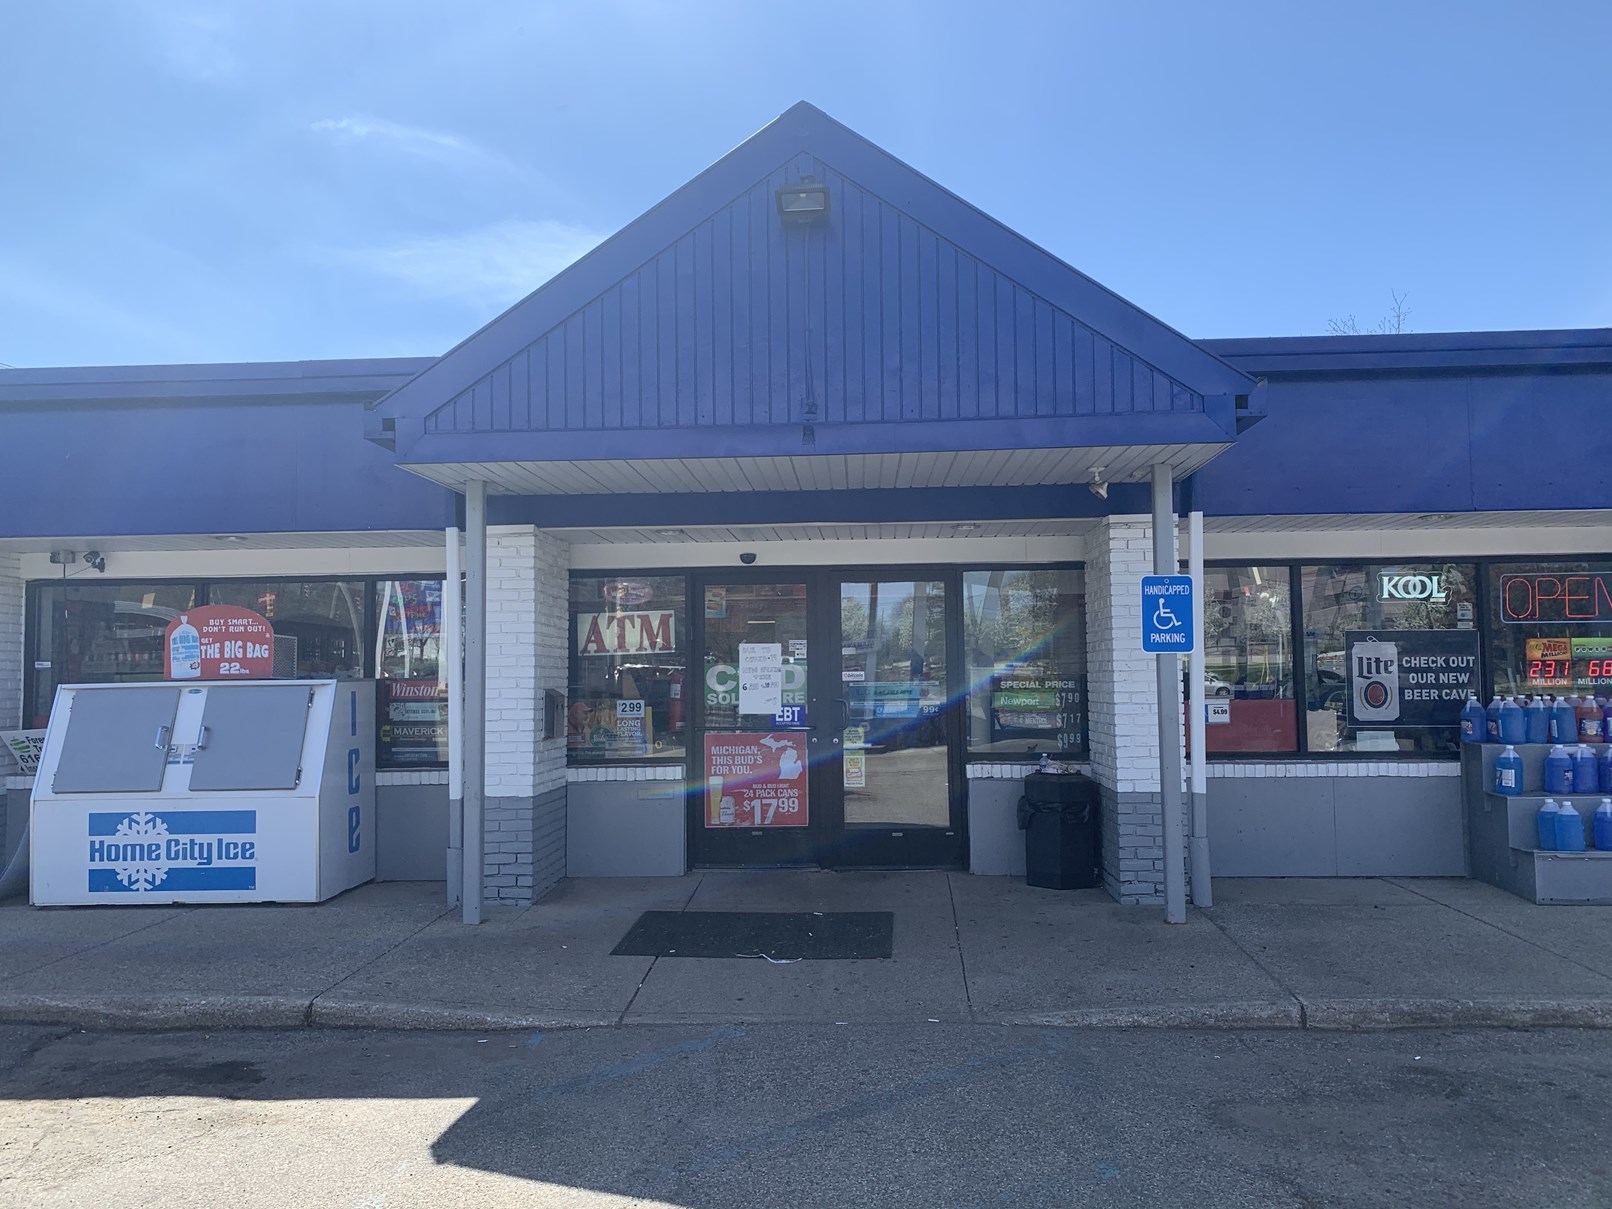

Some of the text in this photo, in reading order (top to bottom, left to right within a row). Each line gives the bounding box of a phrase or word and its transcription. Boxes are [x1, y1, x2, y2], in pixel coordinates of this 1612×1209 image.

[1144, 585, 1190, 595] HANDICAPPED
[1381, 575, 1448, 599] KOOL
[1506, 577, 1612, 619] OPEN
[580, 613, 673, 654] ATM
[1150, 633, 1186, 643] PARKING
[200, 643, 220, 658] THE
[224, 640, 243, 658] BIG
[246, 641, 269, 658] BAG
[1542, 642, 1568, 652] MEGA
[1402, 657, 1475, 667] CHECK OUT
[219, 662, 240, 674] 22
[1356, 656, 1395, 680] Lite
[1529, 661, 1569, 677] 231
[1588, 660, 1612, 676] 68
[1409, 673, 1469, 683] OUR NEW
[1577, 677, 1612, 685] MILLION
[391, 682, 438, 697] Winston
[742, 683, 748, 691] 6
[1404, 689, 1475, 700] BEER CAVE
[1000, 696, 1039, 706] Newport
[775, 706, 800, 721] EBT
[711, 746, 760, 755] MICHIGAN,
[735, 756, 762, 764] BUD'S
[731, 766, 752, 774] YOU.
[778, 789, 799, 797] CANS
[89, 838, 255, 865] Home City Ice
